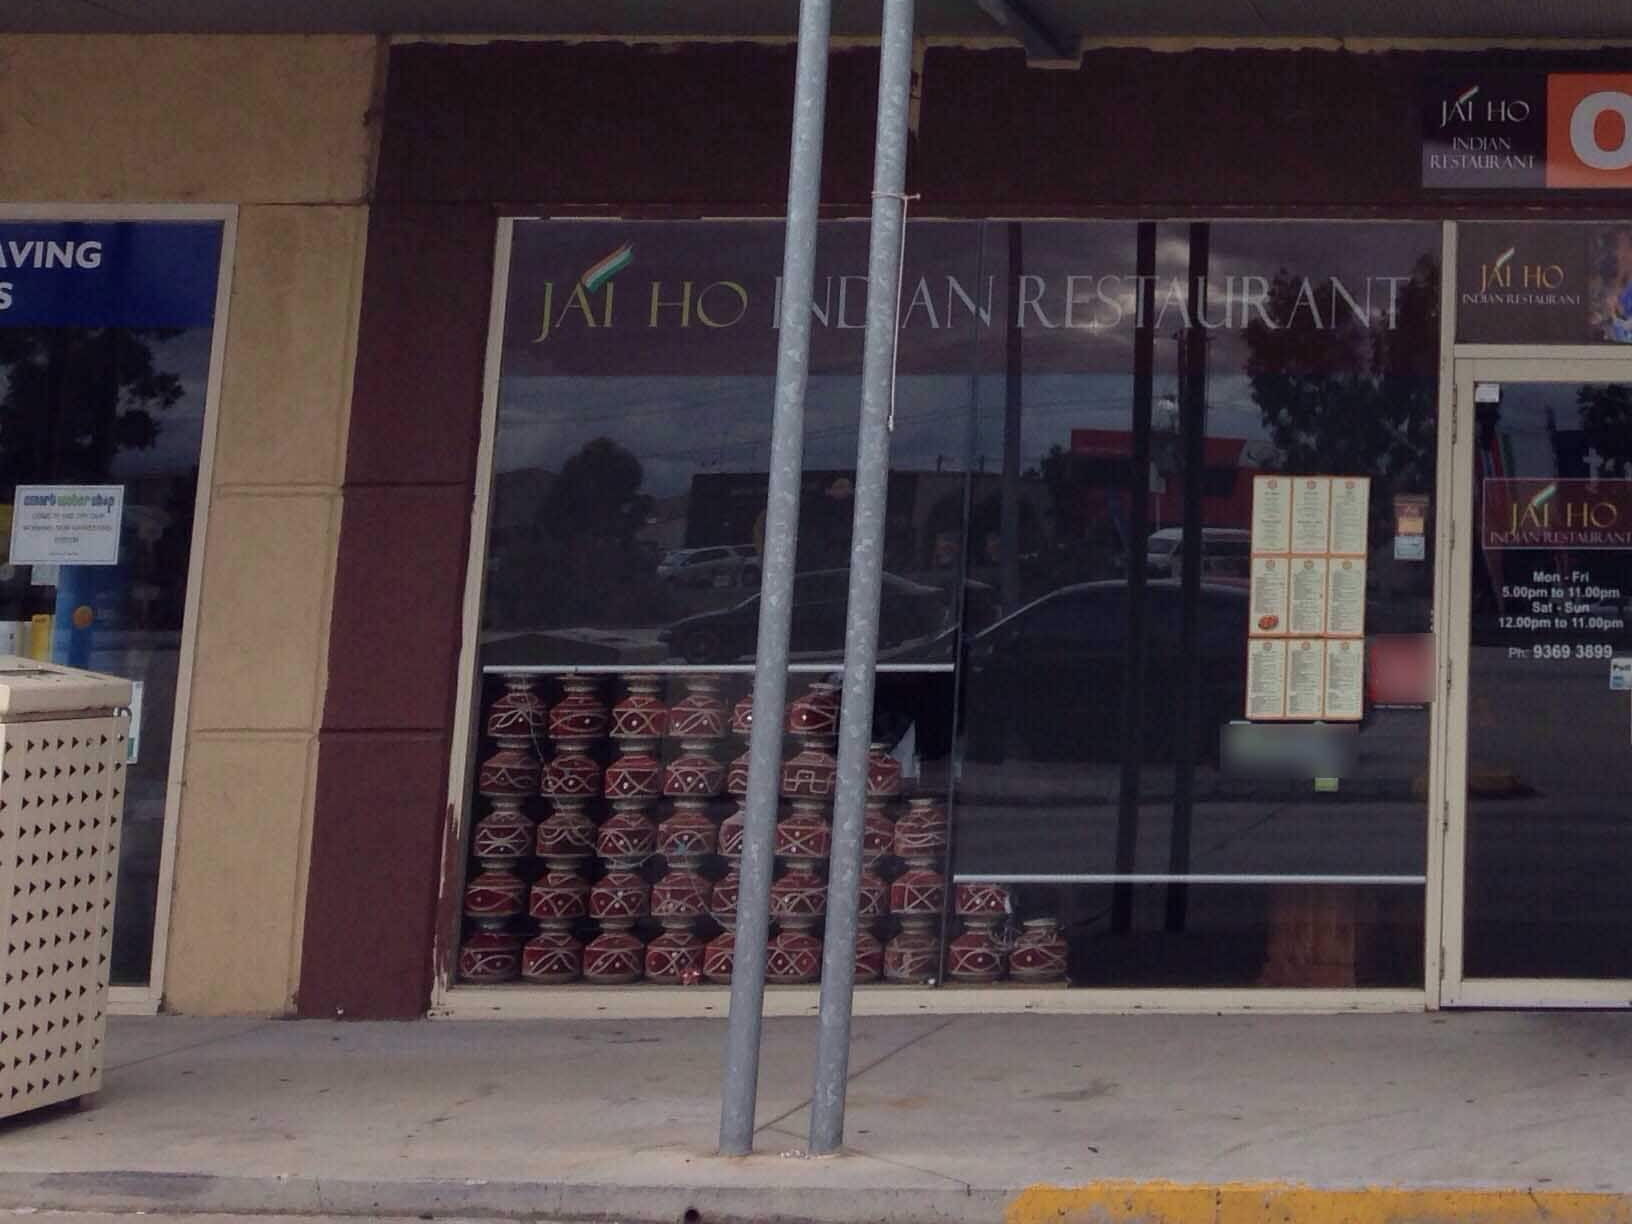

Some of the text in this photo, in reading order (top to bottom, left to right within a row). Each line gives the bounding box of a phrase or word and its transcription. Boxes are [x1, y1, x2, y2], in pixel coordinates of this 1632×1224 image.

[1440, 100, 1530, 128] JAI HO
[1451, 135, 1512, 151] INDIAN
[1429, 154, 1535, 169] RESTAURANT
[1480, 263, 1565, 294] JAI HO
[531, 274, 1411, 343] JAI HO INDAN RESTAURANT
[1510, 502, 1617, 536] JAI HO
[1532, 571, 1561, 583] Mon
[1572, 571, 1590, 583] Fri
[1502, 586, 1620, 600] 5.00pm to 11.00pm
[1531, 601, 1553, 613] Sat
[1564, 601, 1591, 614] Sun
[1499, 617, 1624, 631] 12.00pm to 11.00pm
[1533, 644, 1571, 659] 9369
[1575, 644, 1613, 659] 3899
